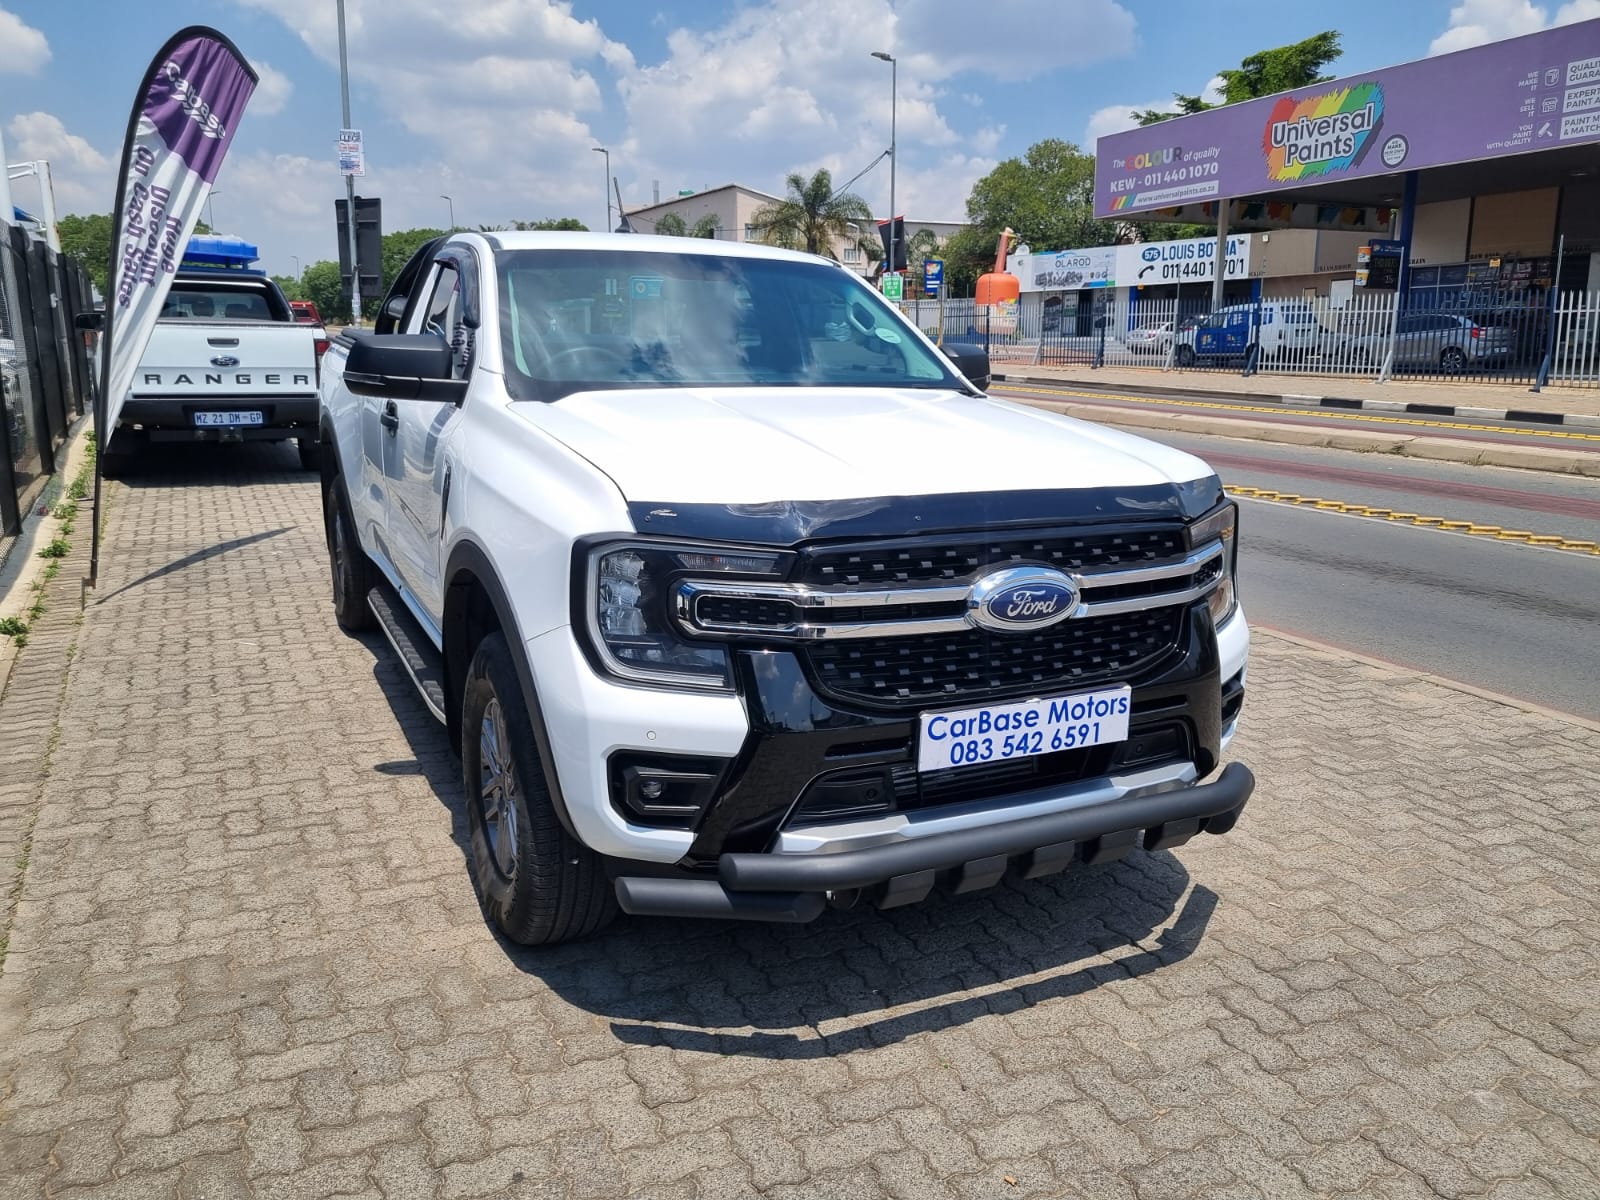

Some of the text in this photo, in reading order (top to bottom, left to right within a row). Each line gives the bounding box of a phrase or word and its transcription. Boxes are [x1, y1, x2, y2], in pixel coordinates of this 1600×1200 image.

[1520, 104, 1536, 112] SELL
[1566, 97, 1594, 108] PAINT
[1273, 103, 1372, 146] Universal
[1519, 124, 1533, 132] YOU
[1565, 116, 1591, 127] PAINT
[1486, 137, 1532, 150] WITH QUALITY
[1512, 130, 1532, 138] PAINT
[1112, 146, 1220, 171] The COLOUR of quality
[1286, 135, 1353, 164] Paints
[1110, 176, 1136, 192] KEW
[1144, 172, 1162, 186] 011
[1164, 168, 1186, 183] 440
[1189, 162, 1218, 180] 1070
[1137, 185, 1215, 204] www.universalpaints.co.za
[126, 182, 150, 239] Cash
[140, 185, 170, 288] Discount
[160, 215, 182, 274] Huge
[1144, 250, 1158, 260] 575
[1162, 244, 1194, 261] LOUIS
[1055, 258, 1091, 268] OLAROD
[1162, 264, 1179, 278] 011
[1182, 262, 1206, 278] 440
[118, 244, 144, 309] Sales
[144, 374, 308, 385] RANGER
[212, 414, 224, 424] 21
[1007, 590, 1059, 617] Ford
[927, 695, 1128, 741] CarBase Motors
[950, 722, 1100, 764] 083 542 6591
